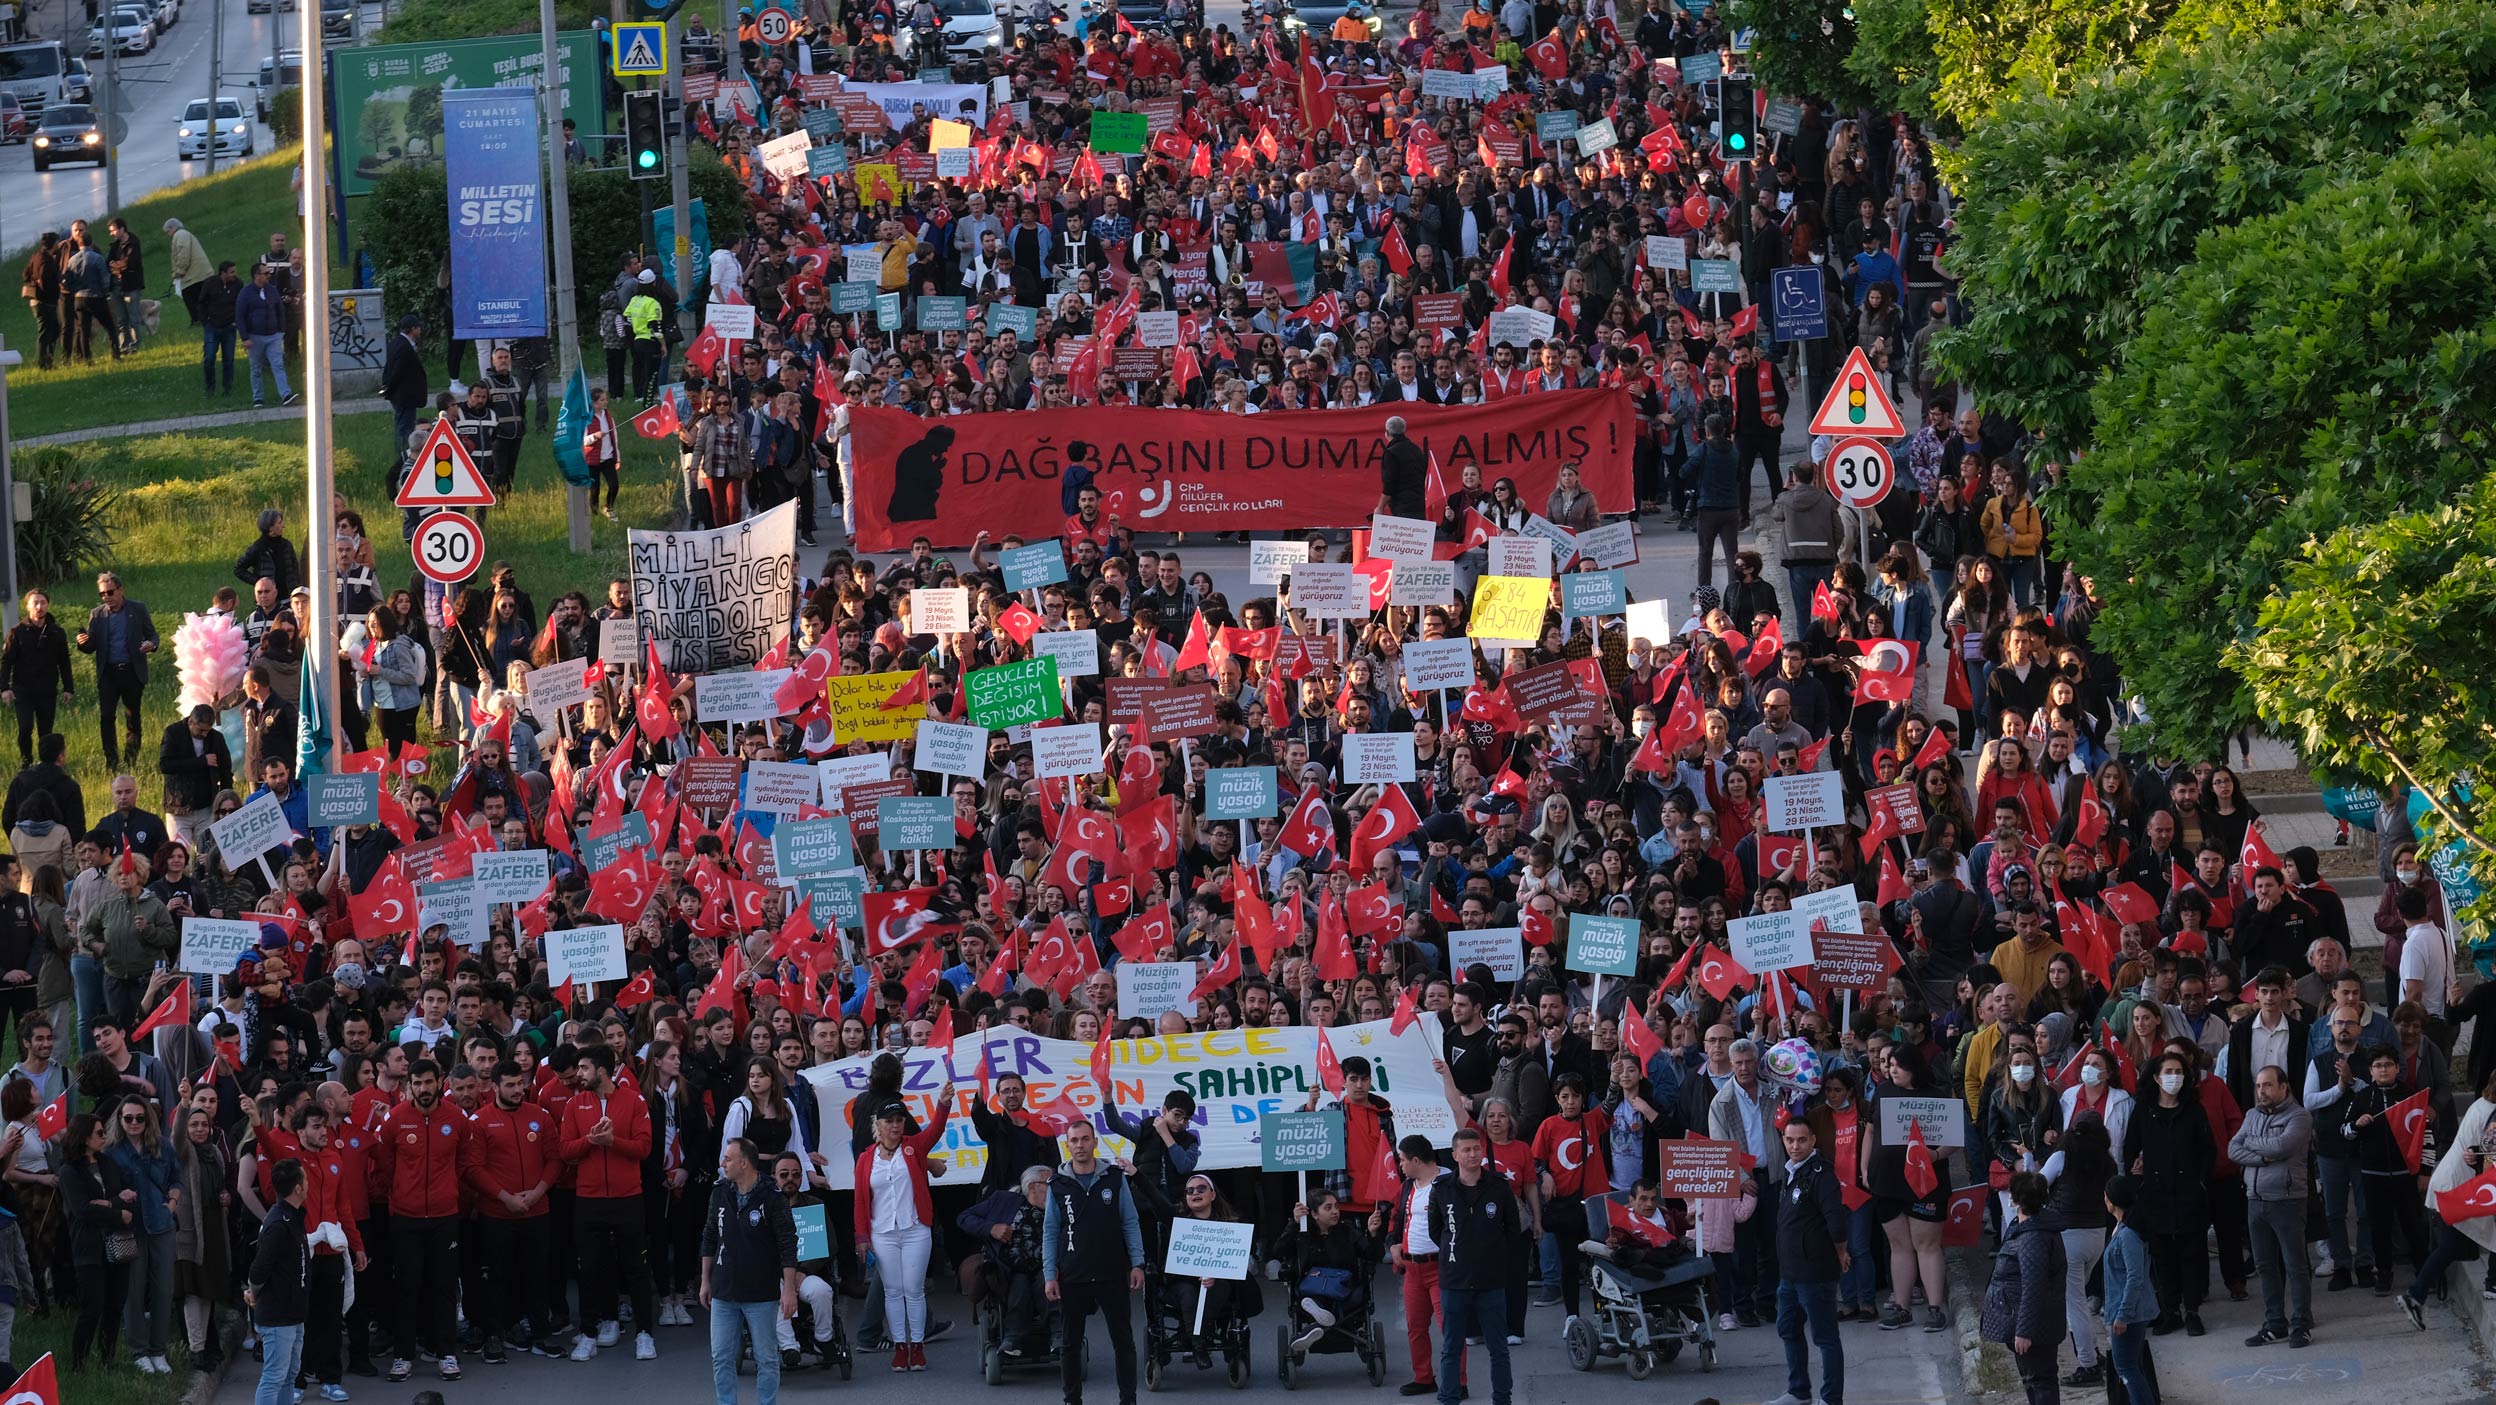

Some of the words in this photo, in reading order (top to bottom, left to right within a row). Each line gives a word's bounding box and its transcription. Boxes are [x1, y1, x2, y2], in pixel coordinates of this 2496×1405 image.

[763, 18, 786, 35] 50
[520, 53, 544, 66] BURS
[466, 109, 477, 117] 21
[482, 108, 517, 116] MAYIS
[849, 259, 881, 271] ZAFERE
[1697, 280, 1734, 291] hürriyet!
[840, 289, 869, 299] müzik
[478, 301, 521, 311] İSTANBUL
[839, 296, 871, 309] yasağı
[924, 310, 959, 321] yaşasın
[997, 312, 1027, 324] müzik
[923, 318, 961, 328] hürriyet!
[962, 436, 1059, 485] DAĞ
[1245, 436, 1429, 470] DUMA
[1448, 425, 1591, 467] ALMIŞ
[1840, 457, 1880, 488] 30
[1180, 483, 1204, 492] CHP
[427, 532, 469, 562] 30
[632, 523, 752, 573] MİLLİ
[1379, 544, 1424, 556] yürüyoruz
[635, 554, 791, 609] PİYANGO
[1395, 573, 1452, 586] ZAFERE
[1574, 579, 1613, 594] müzik
[1300, 592, 1344, 602] yürüyoruz
[1573, 593, 1616, 610] yasağı
[639, 590, 790, 641] ANADOLU
[1417, 670, 1465, 684] yürüyoruz
[700, 694, 734, 705] Bugün,
[735, 691, 760, 701] yarın
[1520, 698, 1548, 712] selam
[1549, 688, 1576, 703] olsun!
[704, 705, 716, 713] ve
[833, 700, 852, 714] Ben
[1151, 721, 1181, 733] selam
[1183, 715, 1213, 728] olsun!
[933, 725, 973, 738] Müziğin
[930, 738, 973, 751] yasağını
[933, 750, 966, 762] kısabilir
[1371, 754, 1398, 763] Mayıs,
[932, 760, 966, 772] misiniz?
[1045, 757, 1093, 770] yürüyoruz
[1373, 763, 1398, 771] Nisan,
[1360, 772, 1371, 780] 29
[1372, 771, 1399, 779] Ekim...
[322, 786, 366, 798] müzik
[686, 780, 736, 792] gençliğimiz
[1220, 778, 1264, 793] müzik
[690, 791, 729, 803] nerede?!
[1217, 792, 1266, 811] yasağı
[1796, 797, 1824, 806] Mayıs,
[319, 799, 368, 816] yasağı
[1785, 807, 1797, 816] 23
[1799, 806, 1826, 814] Nisan,
[1785, 817, 1797, 826] 29
[1799, 815, 1828, 824] Ekim...
[220, 806, 281, 849] ZAFERE
[901, 824, 934, 836] ayağa
[790, 828, 837, 846] müzik
[899, 833, 933, 845] kalktı!
[790, 845, 841, 865] yasağı
[477, 863, 545, 882] ZAFERE
[814, 890, 853, 903] müzik
[1745, 915, 1791, 931] Müziğin
[562, 930, 607, 944] Müziğin
[1582, 928, 1626, 945] müzik
[1746, 930, 1795, 947] yasağını
[562, 943, 610, 960] yasağını
[1577, 944, 1627, 964] yasağı
[1754, 944, 1791, 957] kısabilir
[569, 958, 605, 970] kısabilir
[1755, 954, 1794, 969] misiniz?
[1813, 958, 1884, 973] gençliğimiz
[1135, 966, 1179, 979] Müziğin
[1820, 973, 1875, 985] nerede?!
[1133, 980, 1181, 993] yasağını
[1139, 994, 1176, 1003] kısabilir
[1898, 1101, 1946, 1112] Müziğin
[1277, 1124, 1328, 1141] müzik
[1275, 1140, 1332, 1161] yasağı
[1283, 1156, 1315, 1166] devam!!!
[1666, 1167, 1735, 1180] gençliğimiz
[1674, 1180, 1728, 1193] nerede?!
[1064, 1195, 1075, 1252] ZABITA
[1192, 1225, 1235, 1236] Gösterdiğin
[1447, 1204, 1456, 1262] ZABITA
[1182, 1232, 1203, 1242] yolda
[1204, 1235, 1241, 1244] yürüyoruz
[1173, 1241, 1214, 1255] Bugün,
[1217, 1245, 1246, 1258] yarın
[1176, 1255, 1191, 1264] ve
[1193, 1257, 1238, 1270] daima...
